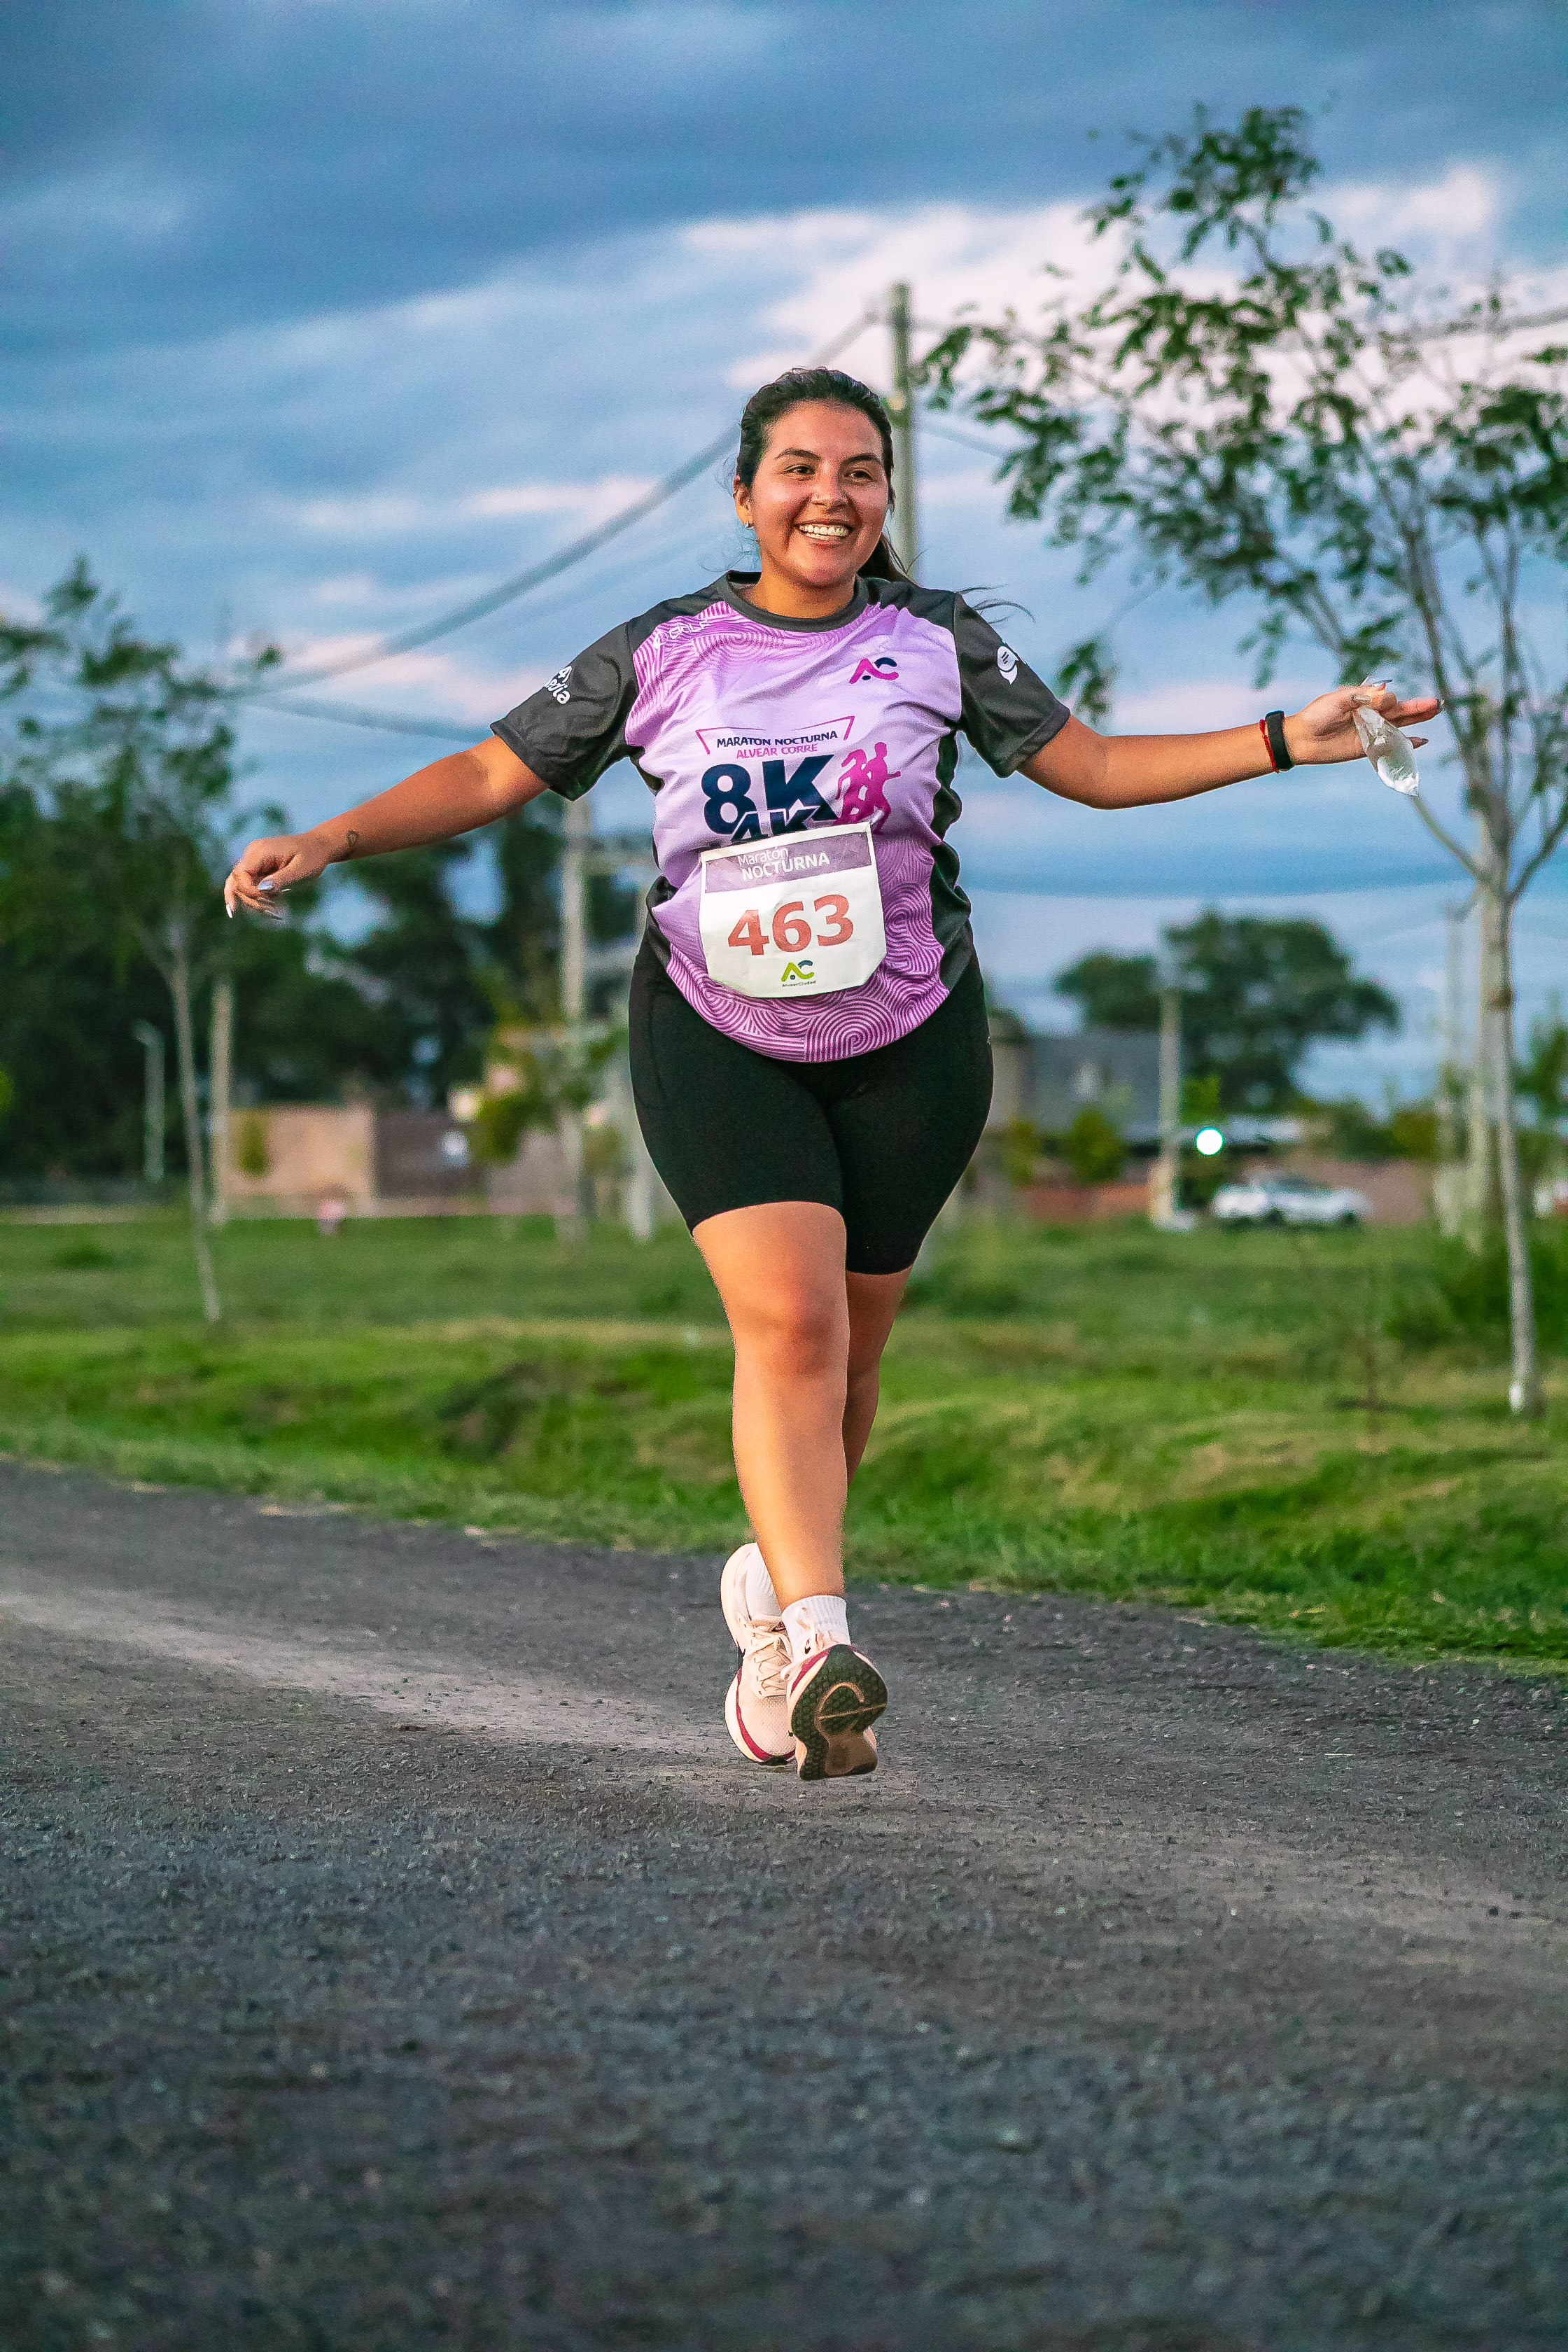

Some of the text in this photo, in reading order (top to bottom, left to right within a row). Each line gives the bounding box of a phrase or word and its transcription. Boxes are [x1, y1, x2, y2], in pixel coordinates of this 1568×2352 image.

[717, 730, 838, 748] MARATON NOCTURNA
[736, 743, 818, 759] ALVEAR CORRE
[701, 755, 840, 835] 8K
[737, 846, 789, 867] Maratón
[741, 851, 831, 881] NOCTURNA
[727, 894, 854, 956] 463
